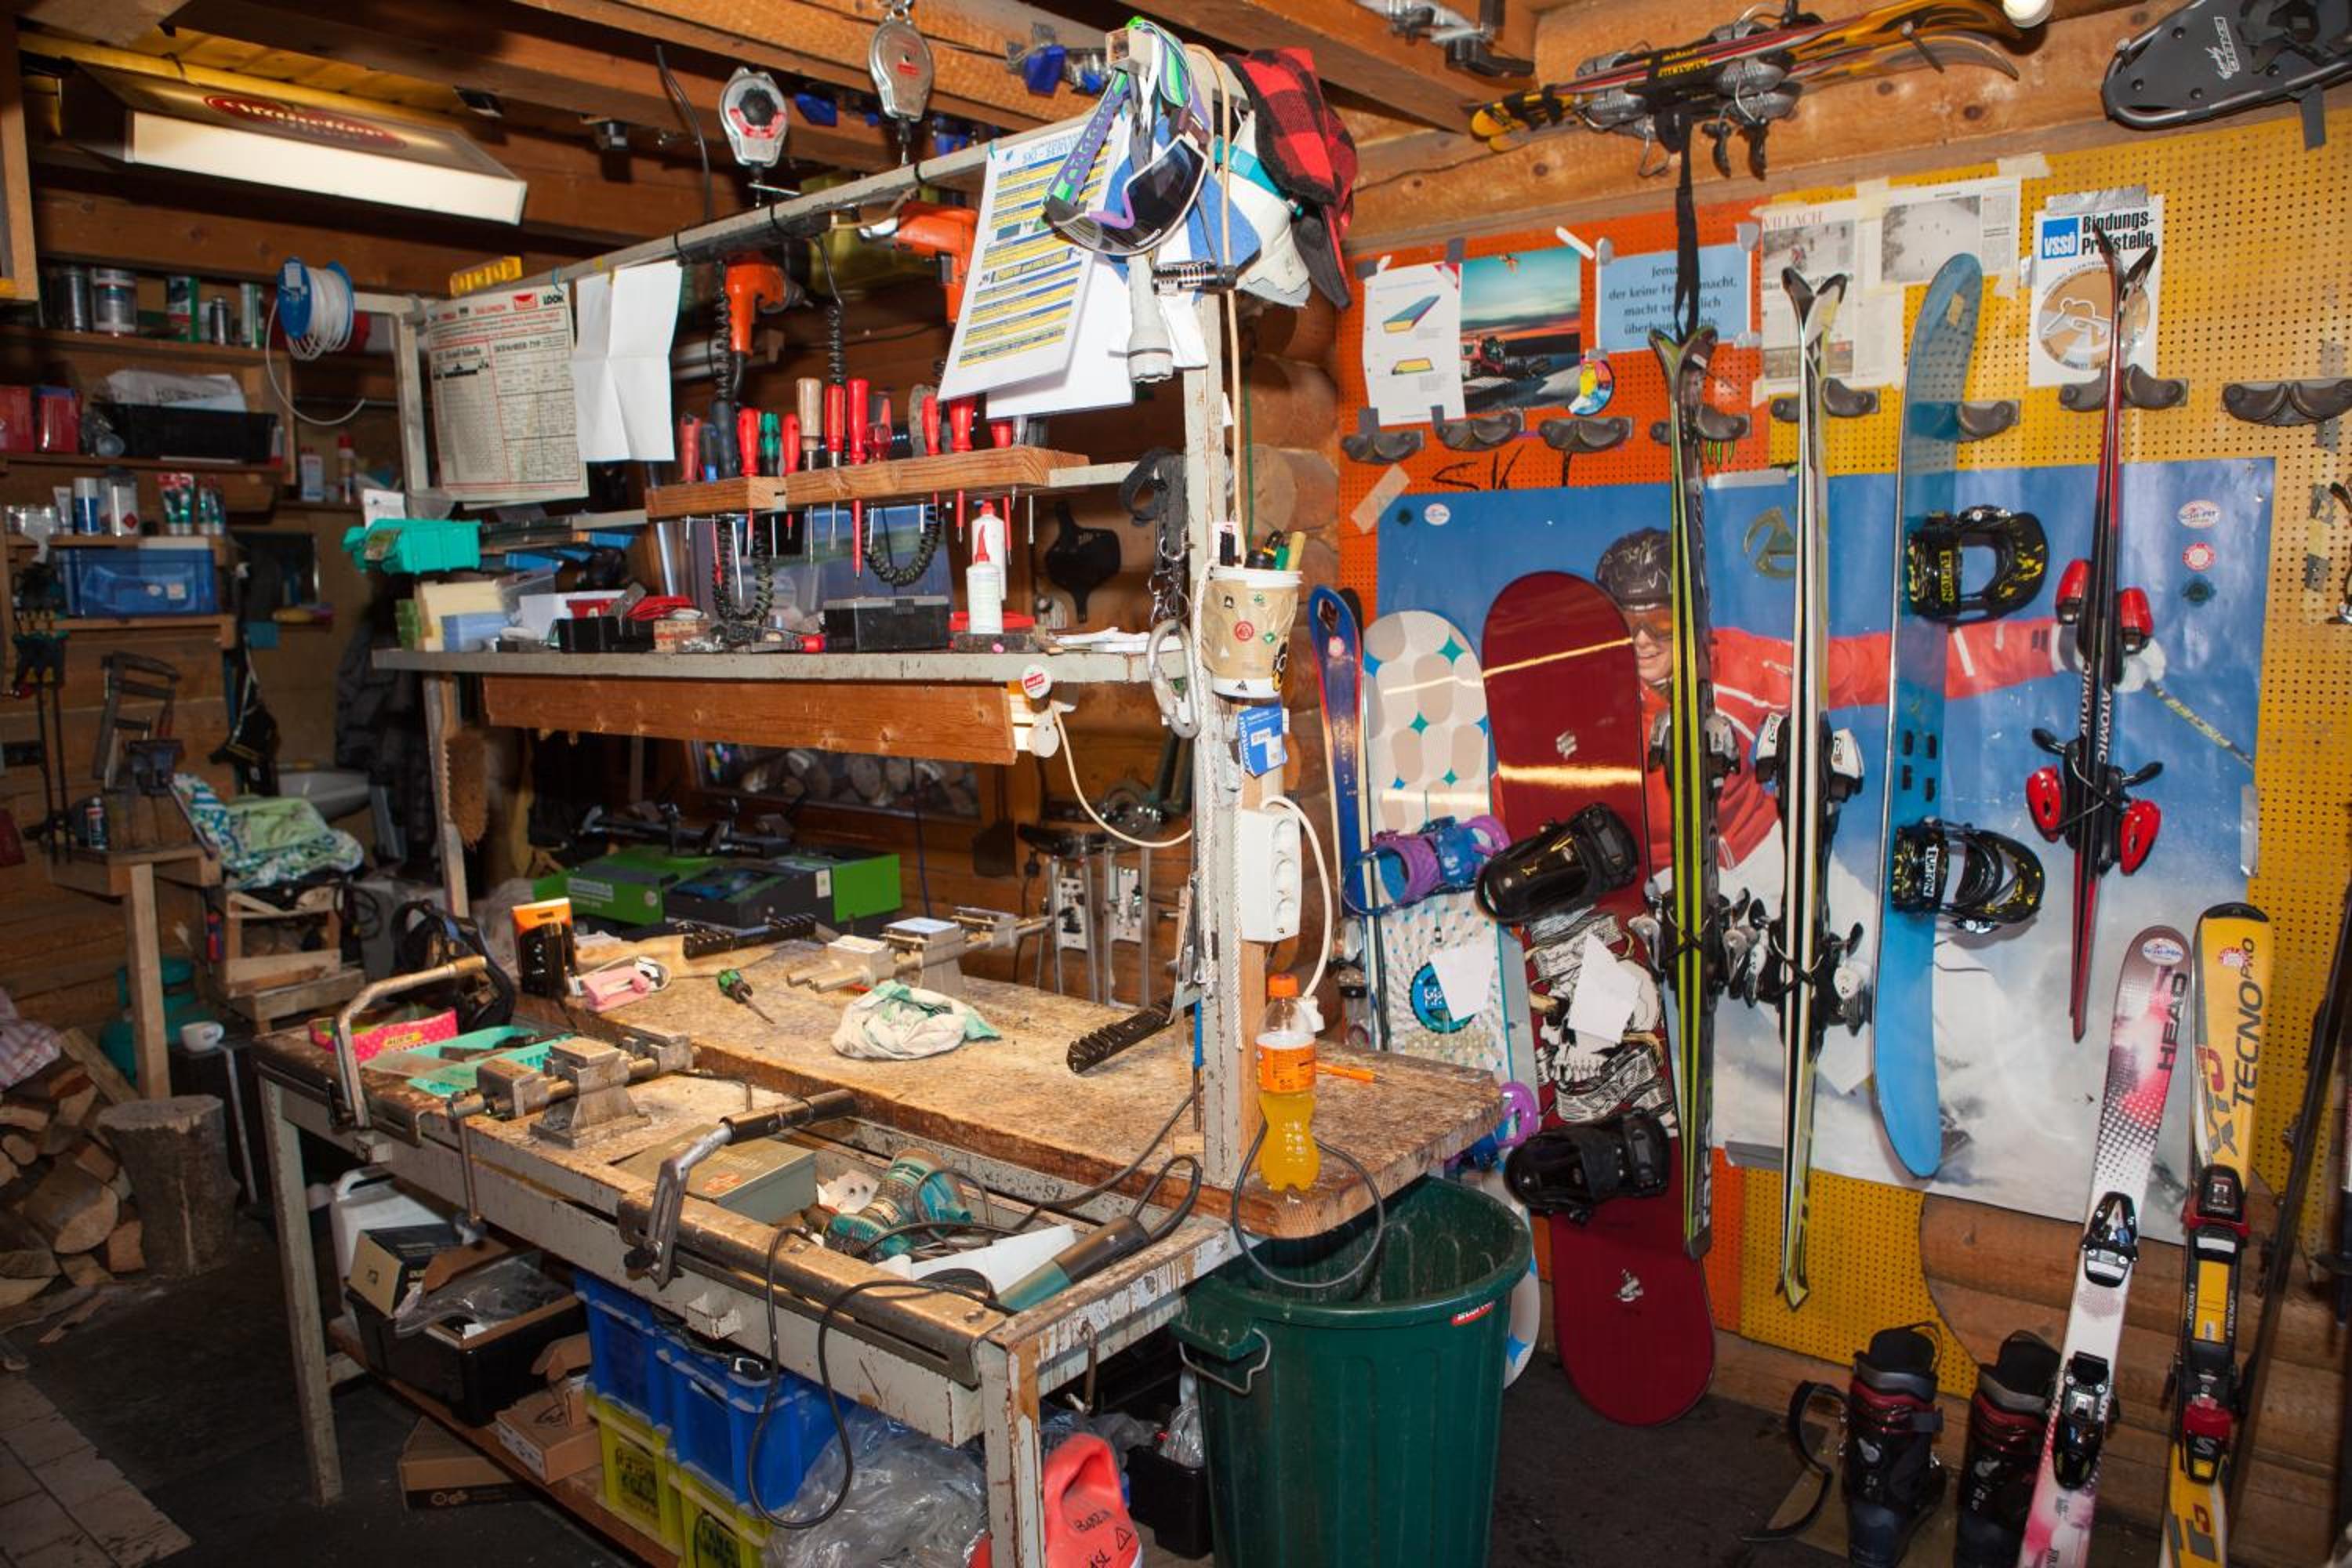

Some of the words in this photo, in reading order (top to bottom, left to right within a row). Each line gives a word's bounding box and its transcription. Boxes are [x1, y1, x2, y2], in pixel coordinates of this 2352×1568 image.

[1608, 290, 1626, 300] der
[1629, 285, 1658, 298] keine
[1624, 303, 1658, 317] macht
[2080, 662, 2091, 737] ATOMIC
[2097, 688, 2111, 764] ATOMIC
[2157, 971, 2188, 1070] HEAD
